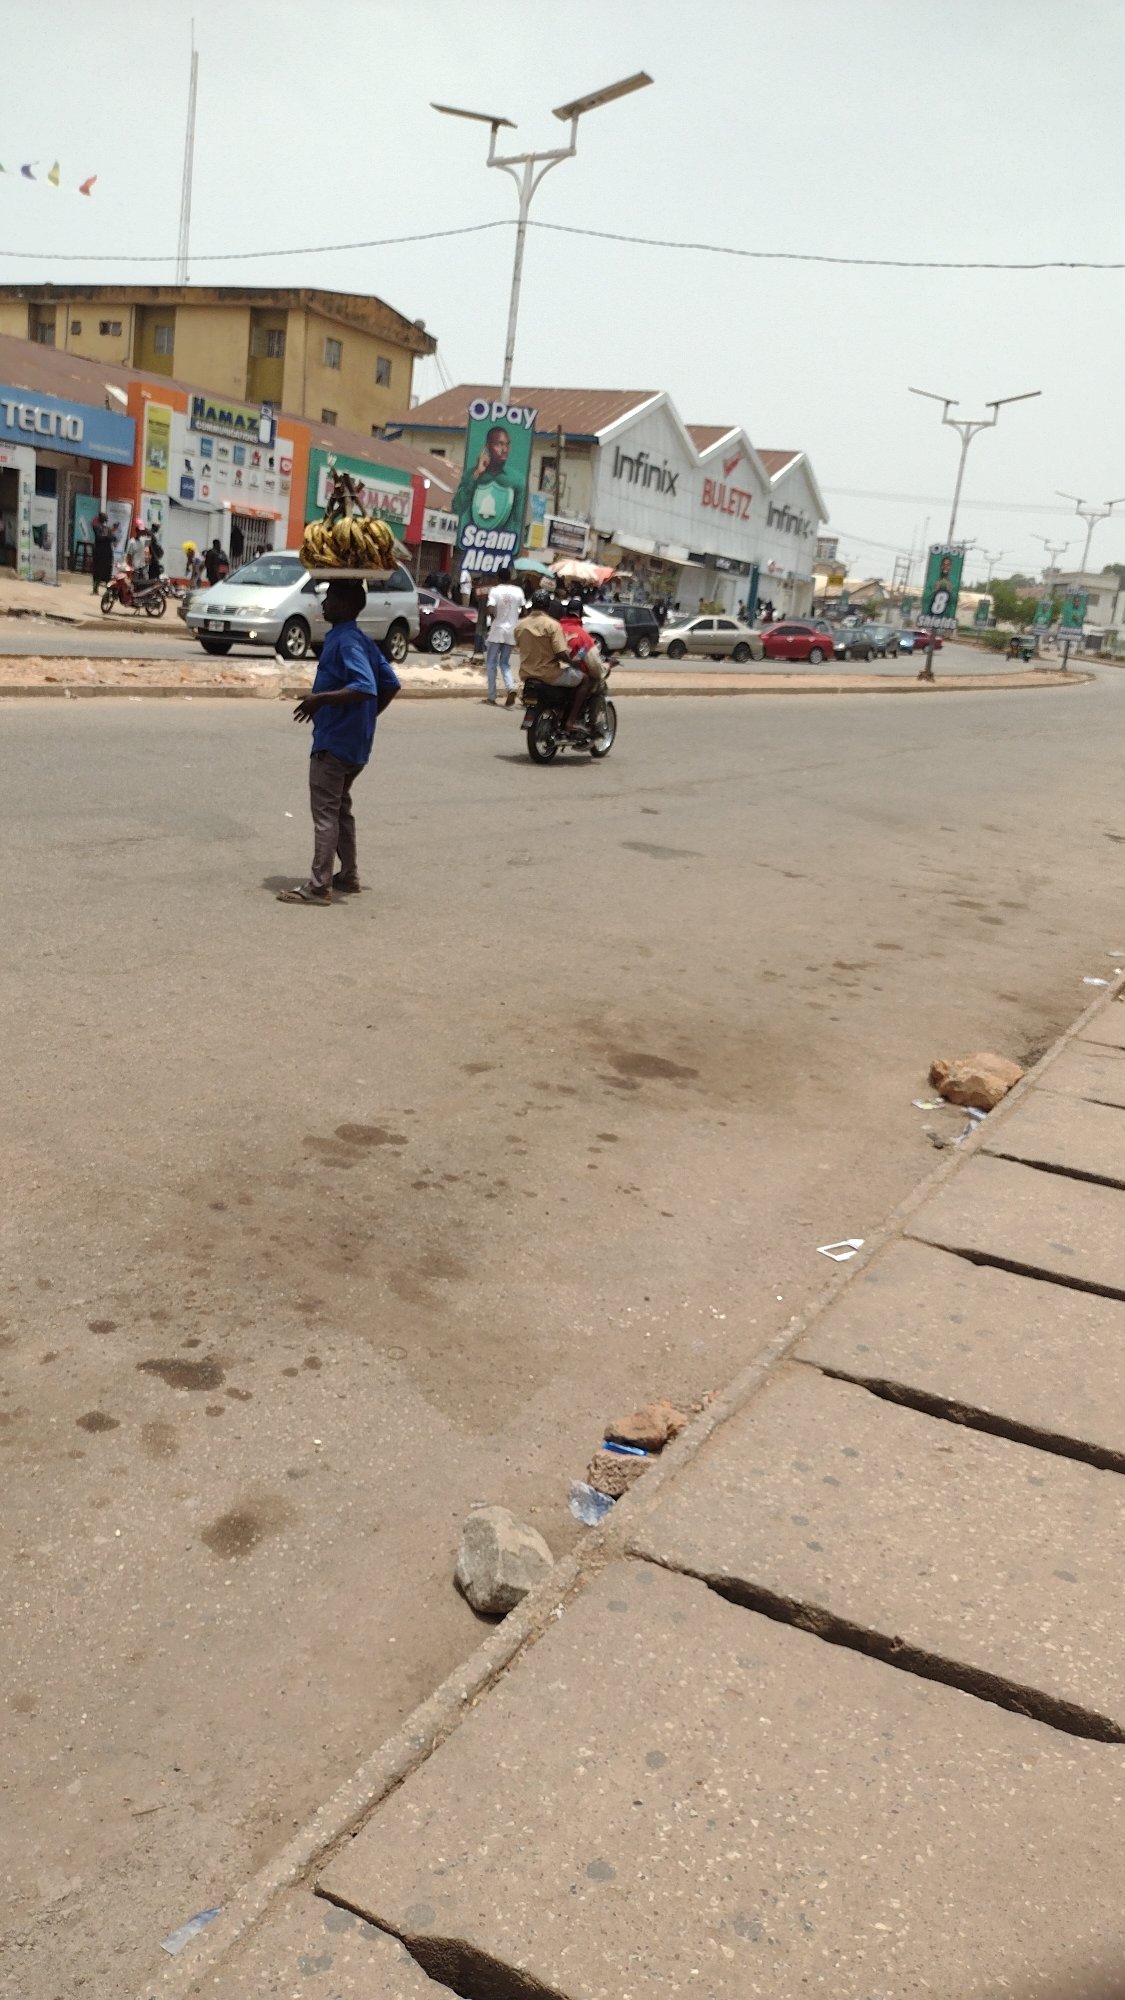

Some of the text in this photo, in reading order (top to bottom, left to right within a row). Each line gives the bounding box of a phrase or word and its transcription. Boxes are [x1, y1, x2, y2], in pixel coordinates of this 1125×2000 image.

[1, 399, 84, 442] TECNO
[193, 397, 258, 430] HAMAZ
[469, 400, 538, 429] OPay
[612, 446, 679, 497] Infinix
[701, 478, 752, 520] BULETZ
[462, 525, 517, 550] Scam
[767, 501, 811, 539] Infinix
[461, 551, 511, 573] Alert
